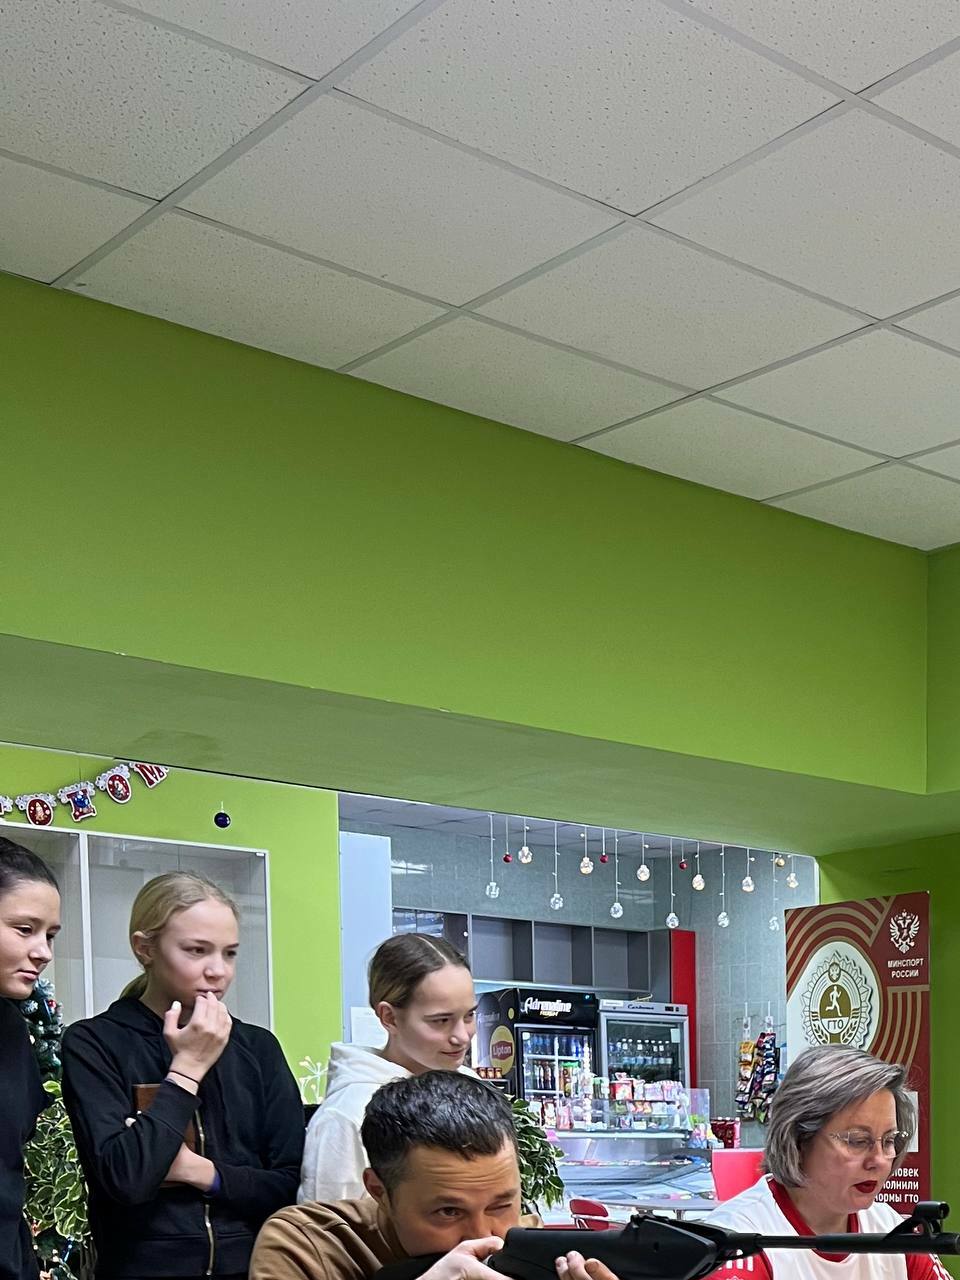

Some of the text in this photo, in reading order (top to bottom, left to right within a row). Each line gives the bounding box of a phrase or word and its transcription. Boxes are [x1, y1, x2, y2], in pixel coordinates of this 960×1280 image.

[887, 958, 924, 968] МИНСПОРТ
[891, 969, 919, 978] РОССИИ
[827, 1019, 844, 1031] ГТО
[492, 1043, 512, 1055] Lipton
[883, 1180, 919, 1190] олнили
